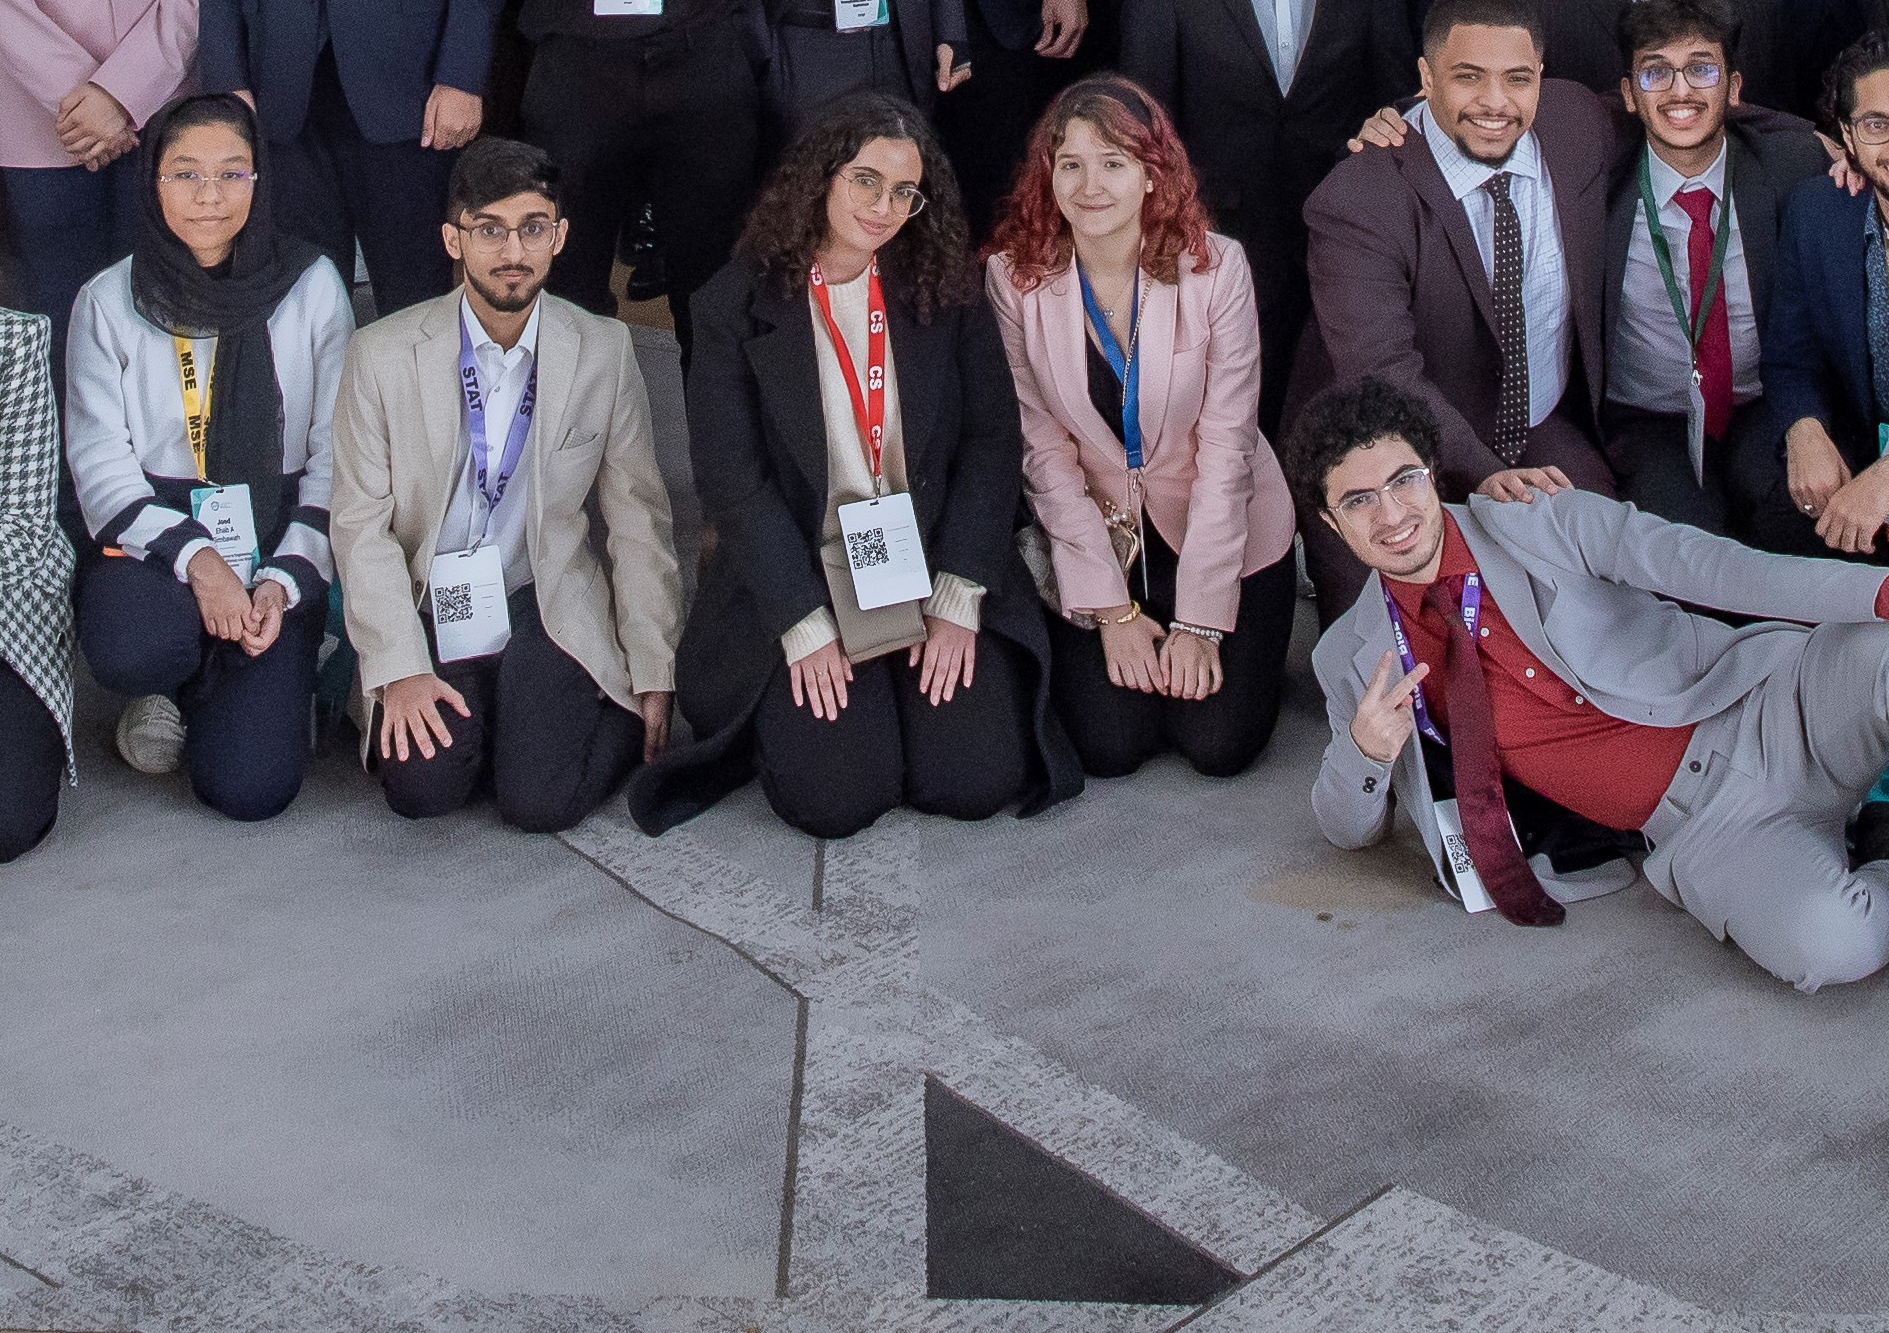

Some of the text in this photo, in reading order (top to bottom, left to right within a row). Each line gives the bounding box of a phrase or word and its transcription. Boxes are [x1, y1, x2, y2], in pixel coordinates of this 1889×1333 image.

[871, 310, 884, 334] CS
[180, 351, 197, 391] MSE
[869, 366, 883, 391] CS
[462, 366, 483, 412] STAT
